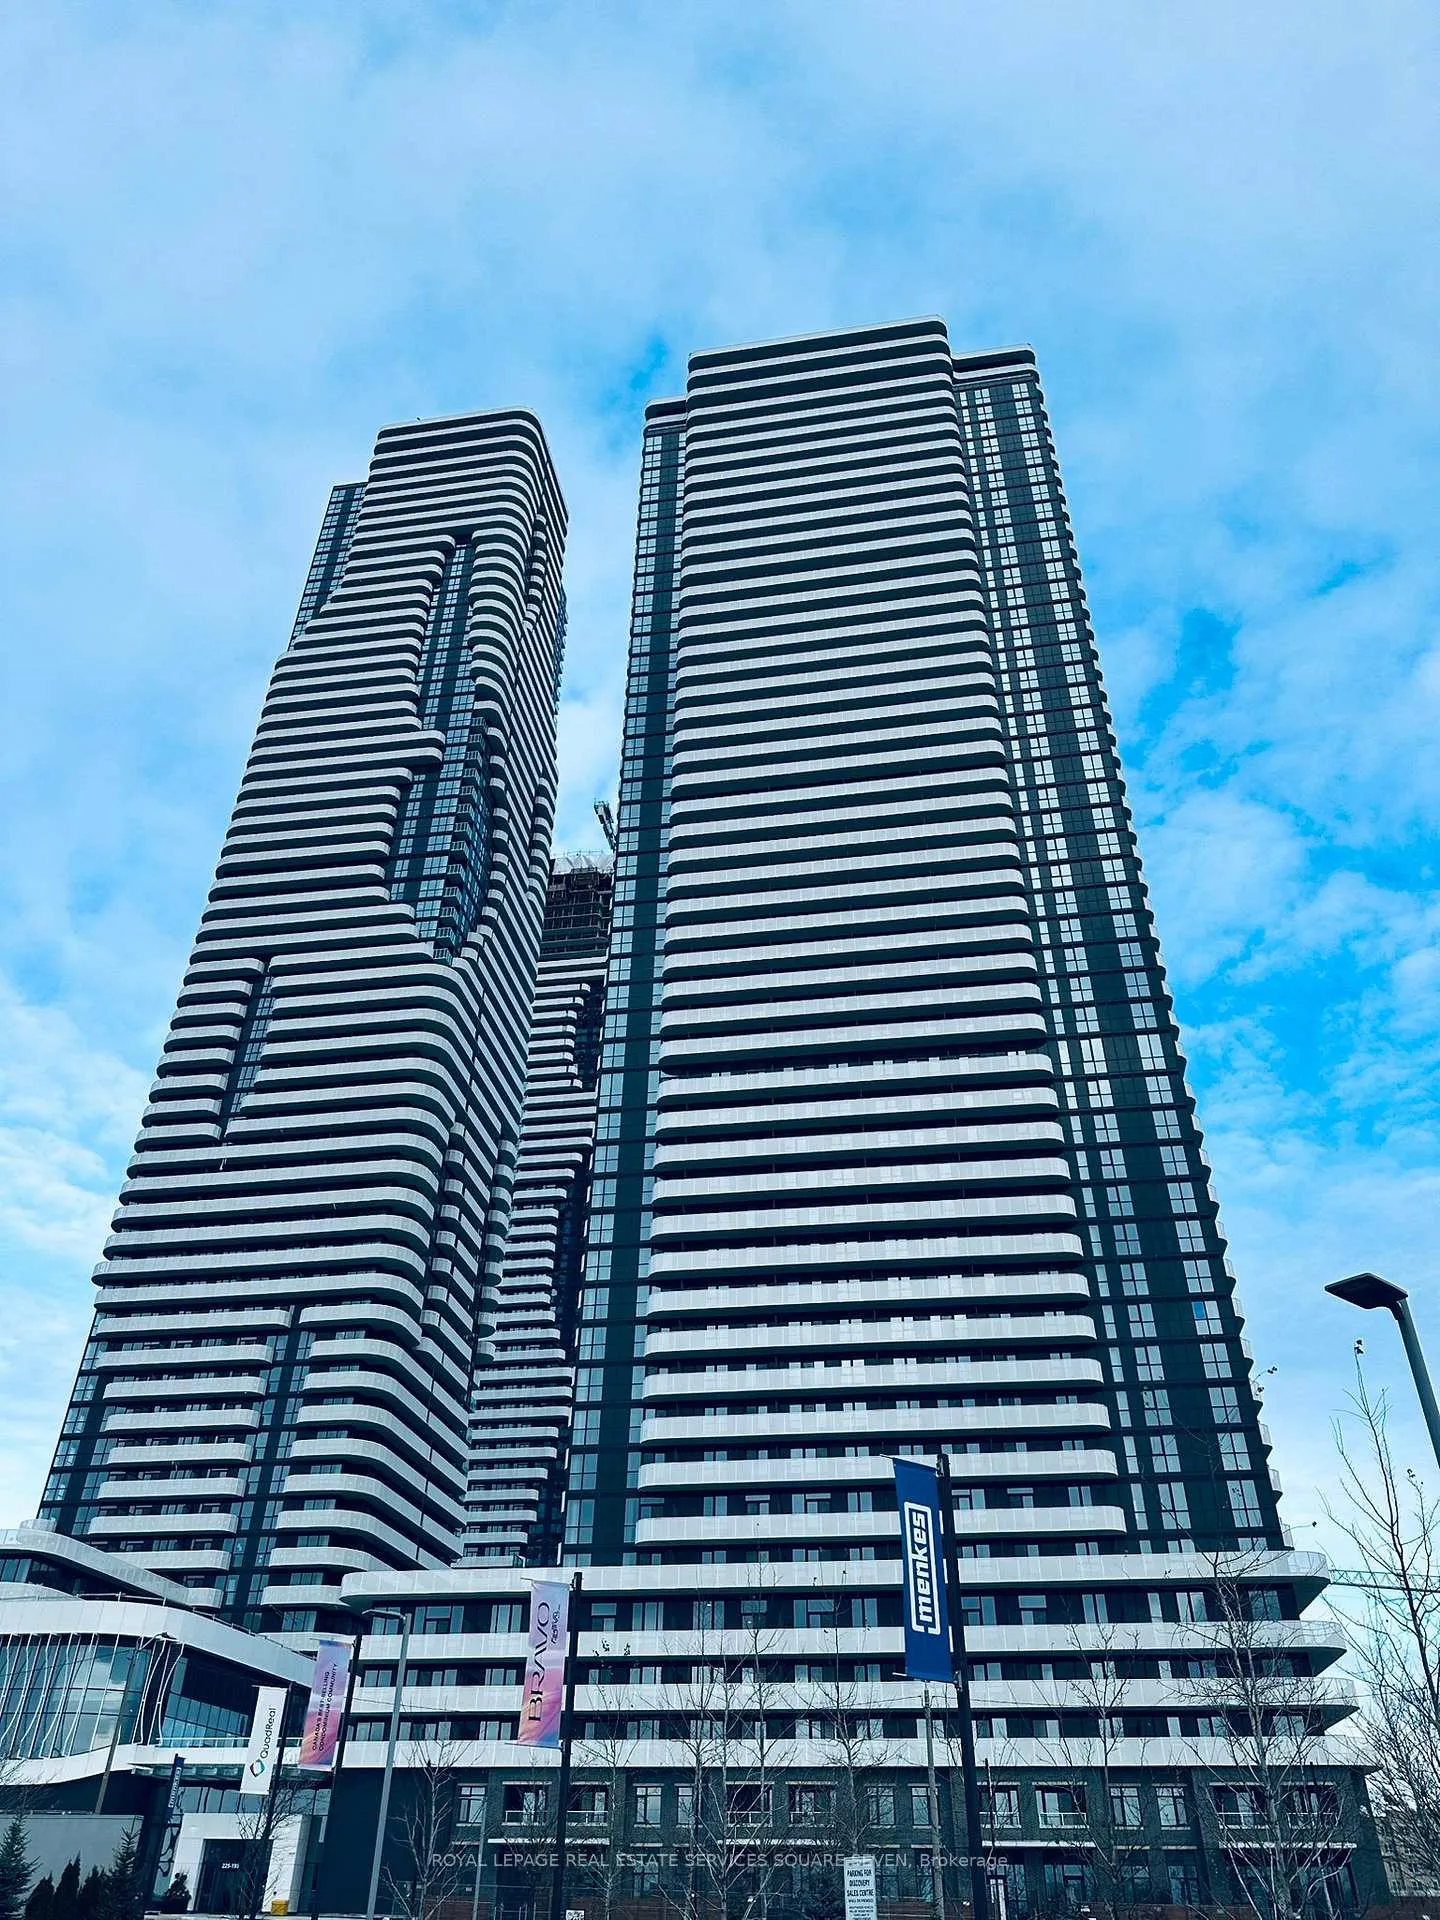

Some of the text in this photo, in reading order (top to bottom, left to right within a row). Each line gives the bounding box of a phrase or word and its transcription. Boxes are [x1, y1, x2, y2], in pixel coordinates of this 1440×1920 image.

[911, 1511, 933, 1623] menkes
[528, 1602, 550, 1721] BRAVO
[260, 1707, 276, 1759] QuadReal
[312, 1718, 322, 1751] CANADA'S
[319, 1663, 338, 1752] CONDOMINIUM COMMUNITY
